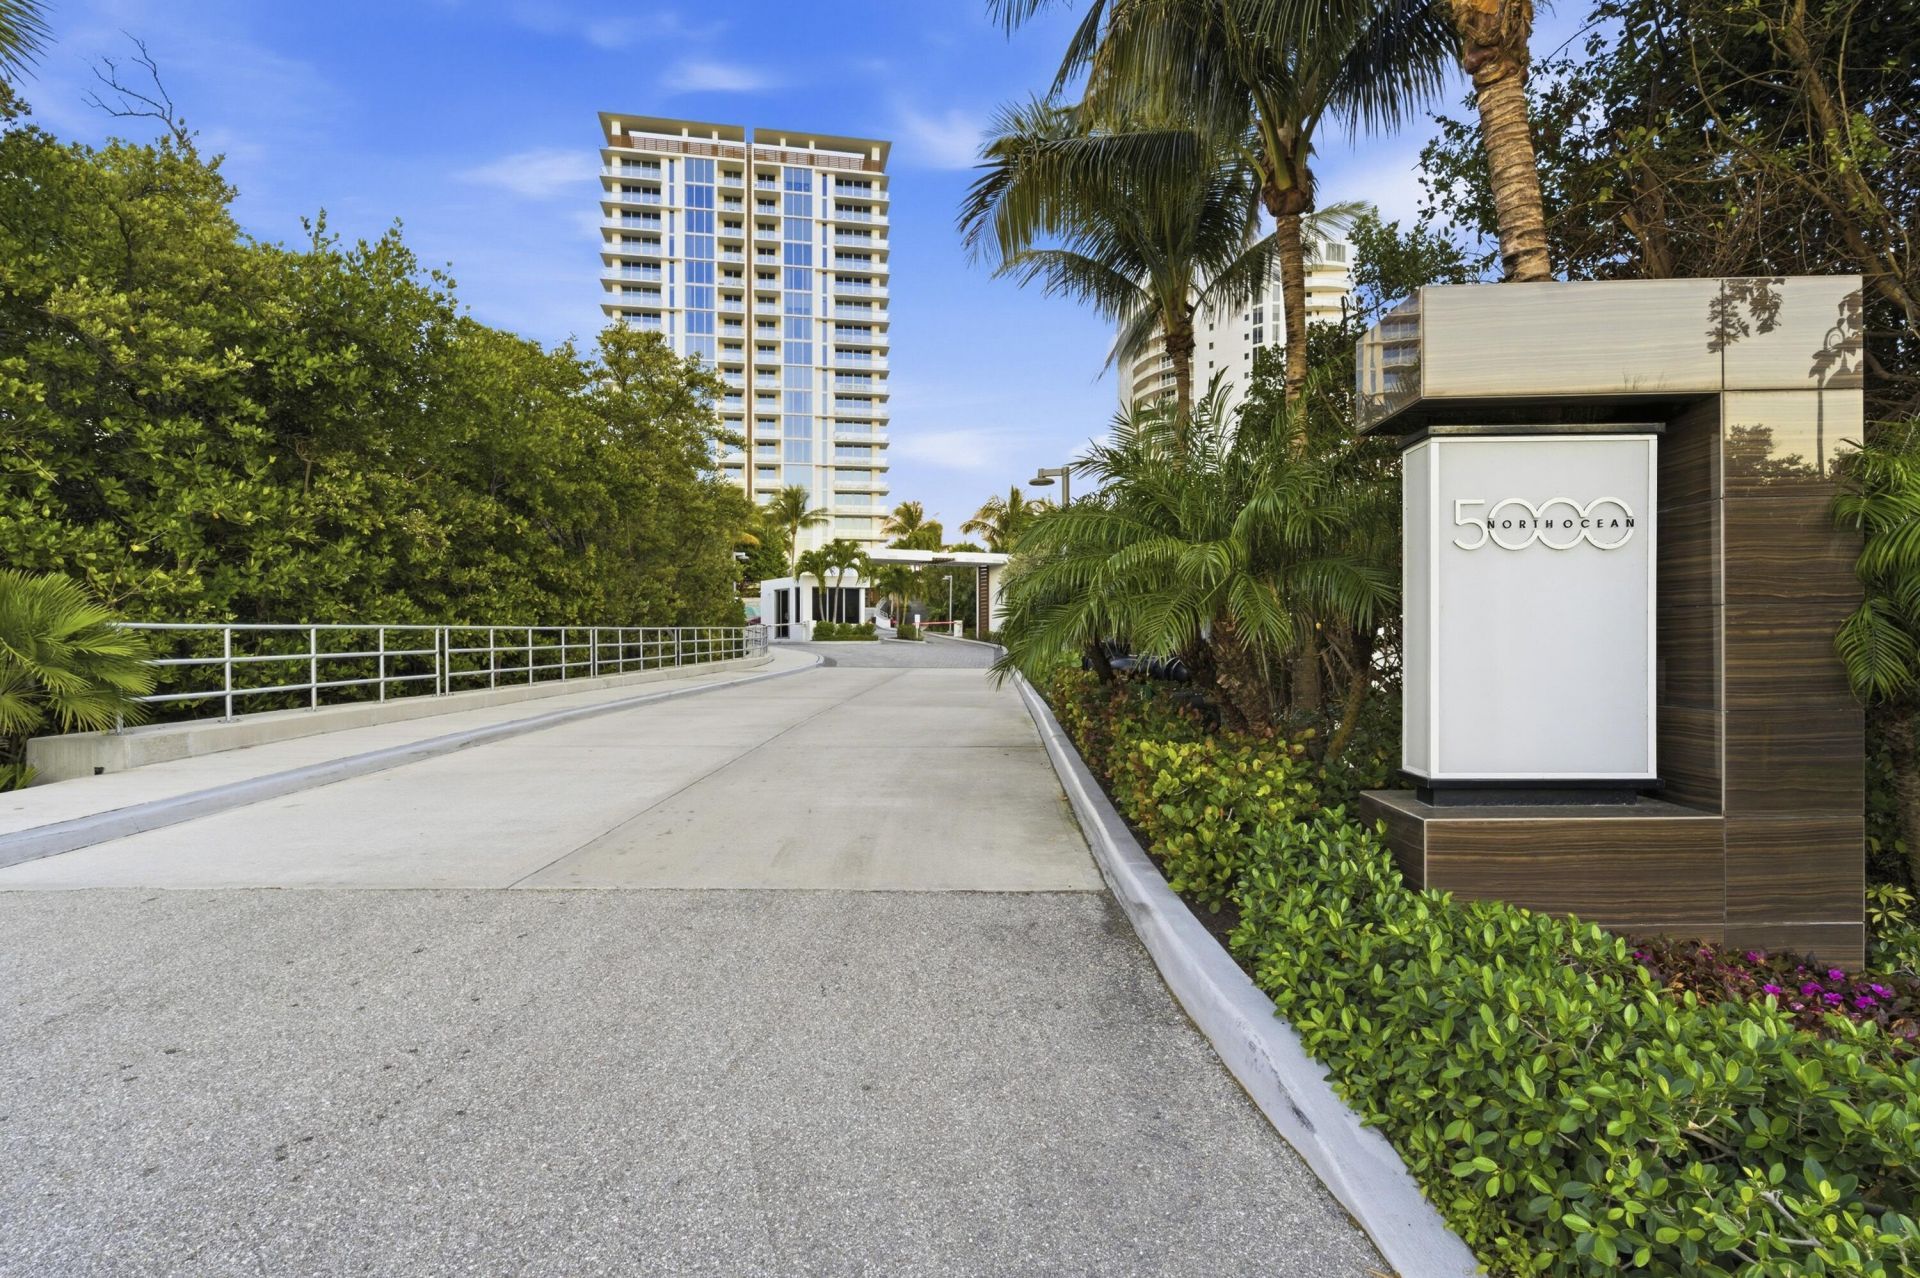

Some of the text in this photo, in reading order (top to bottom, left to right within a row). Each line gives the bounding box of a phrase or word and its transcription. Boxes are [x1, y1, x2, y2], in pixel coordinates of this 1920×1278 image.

[1453, 497, 1635, 551] 5000
[1487, 518, 1635, 529] NORTH OCEAN
